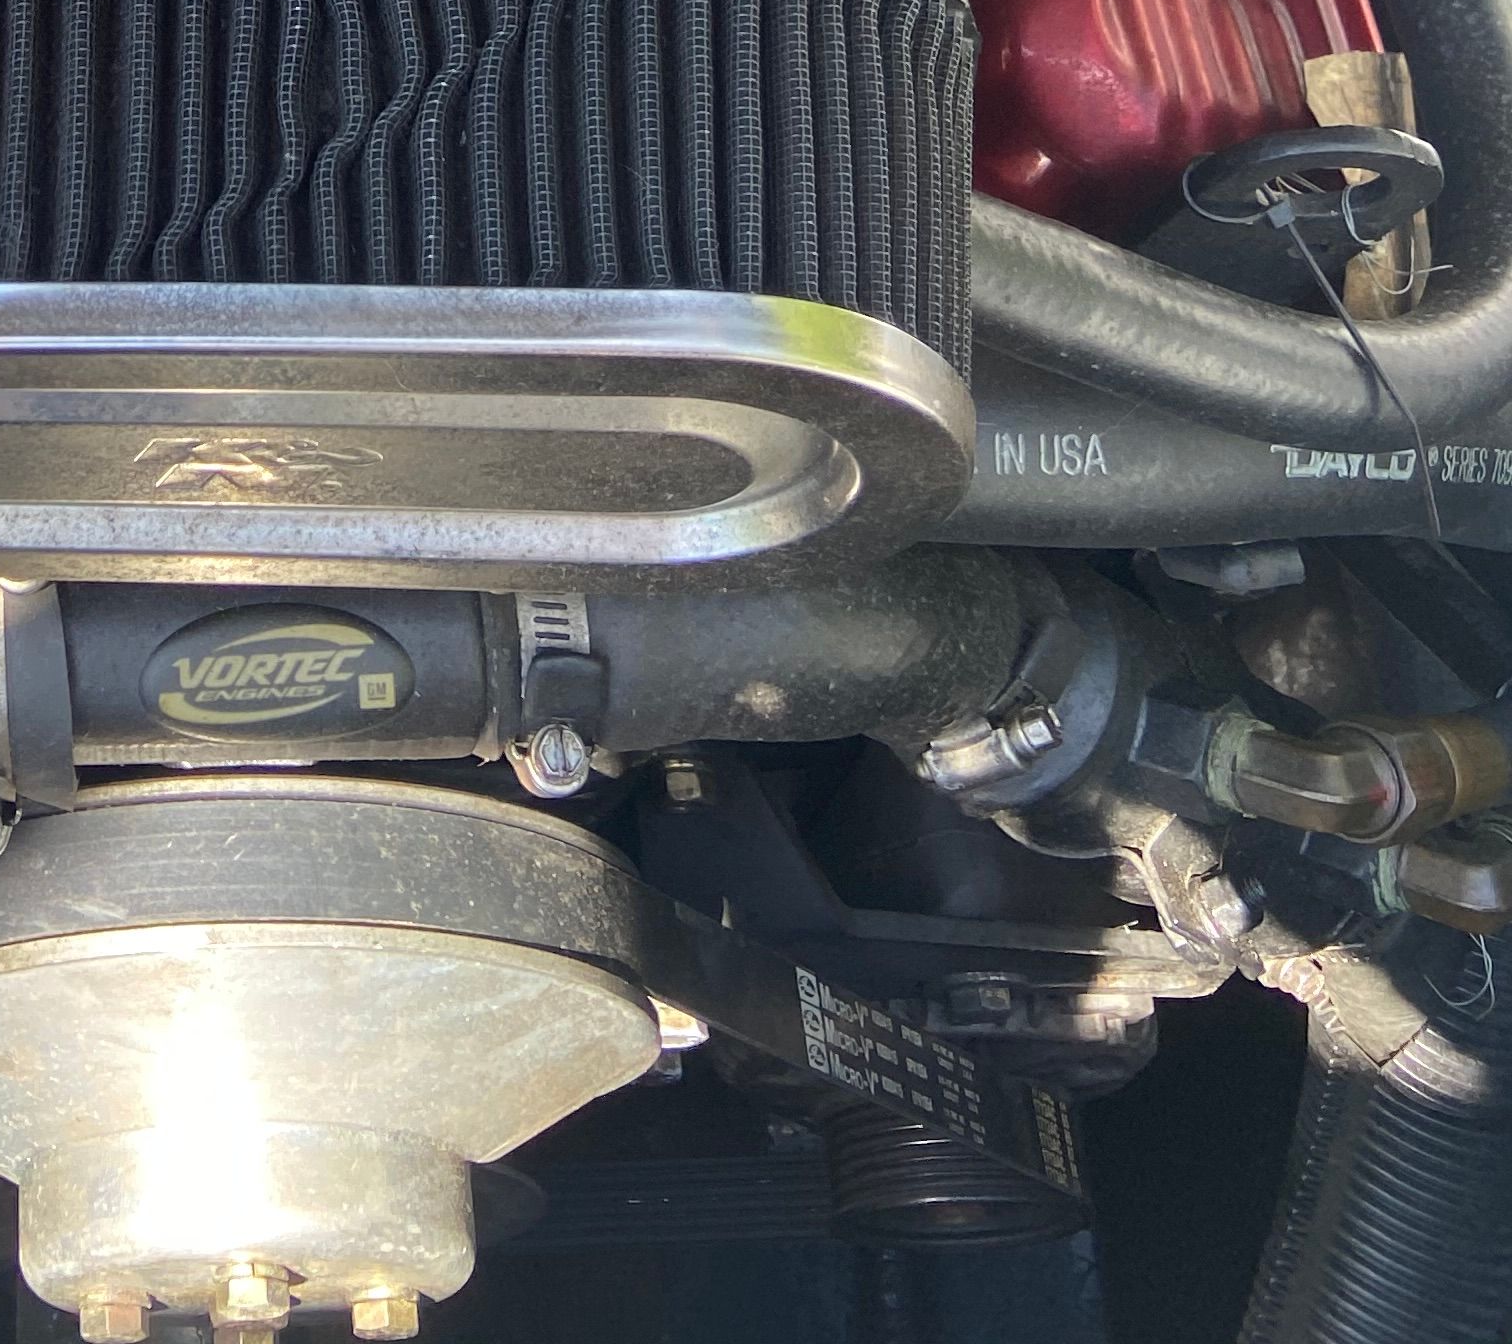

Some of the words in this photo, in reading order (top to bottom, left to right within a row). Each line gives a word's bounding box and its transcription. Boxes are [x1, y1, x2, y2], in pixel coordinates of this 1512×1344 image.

[994, 431, 1026, 476] IN
[1039, 432, 1109, 477] USA
[1270, 443, 1417, 481] DAYCO
[1441, 445, 1489, 484] SERIES
[172, 647, 365, 688] VORTEC
[195, 684, 326, 703] ENGINES
